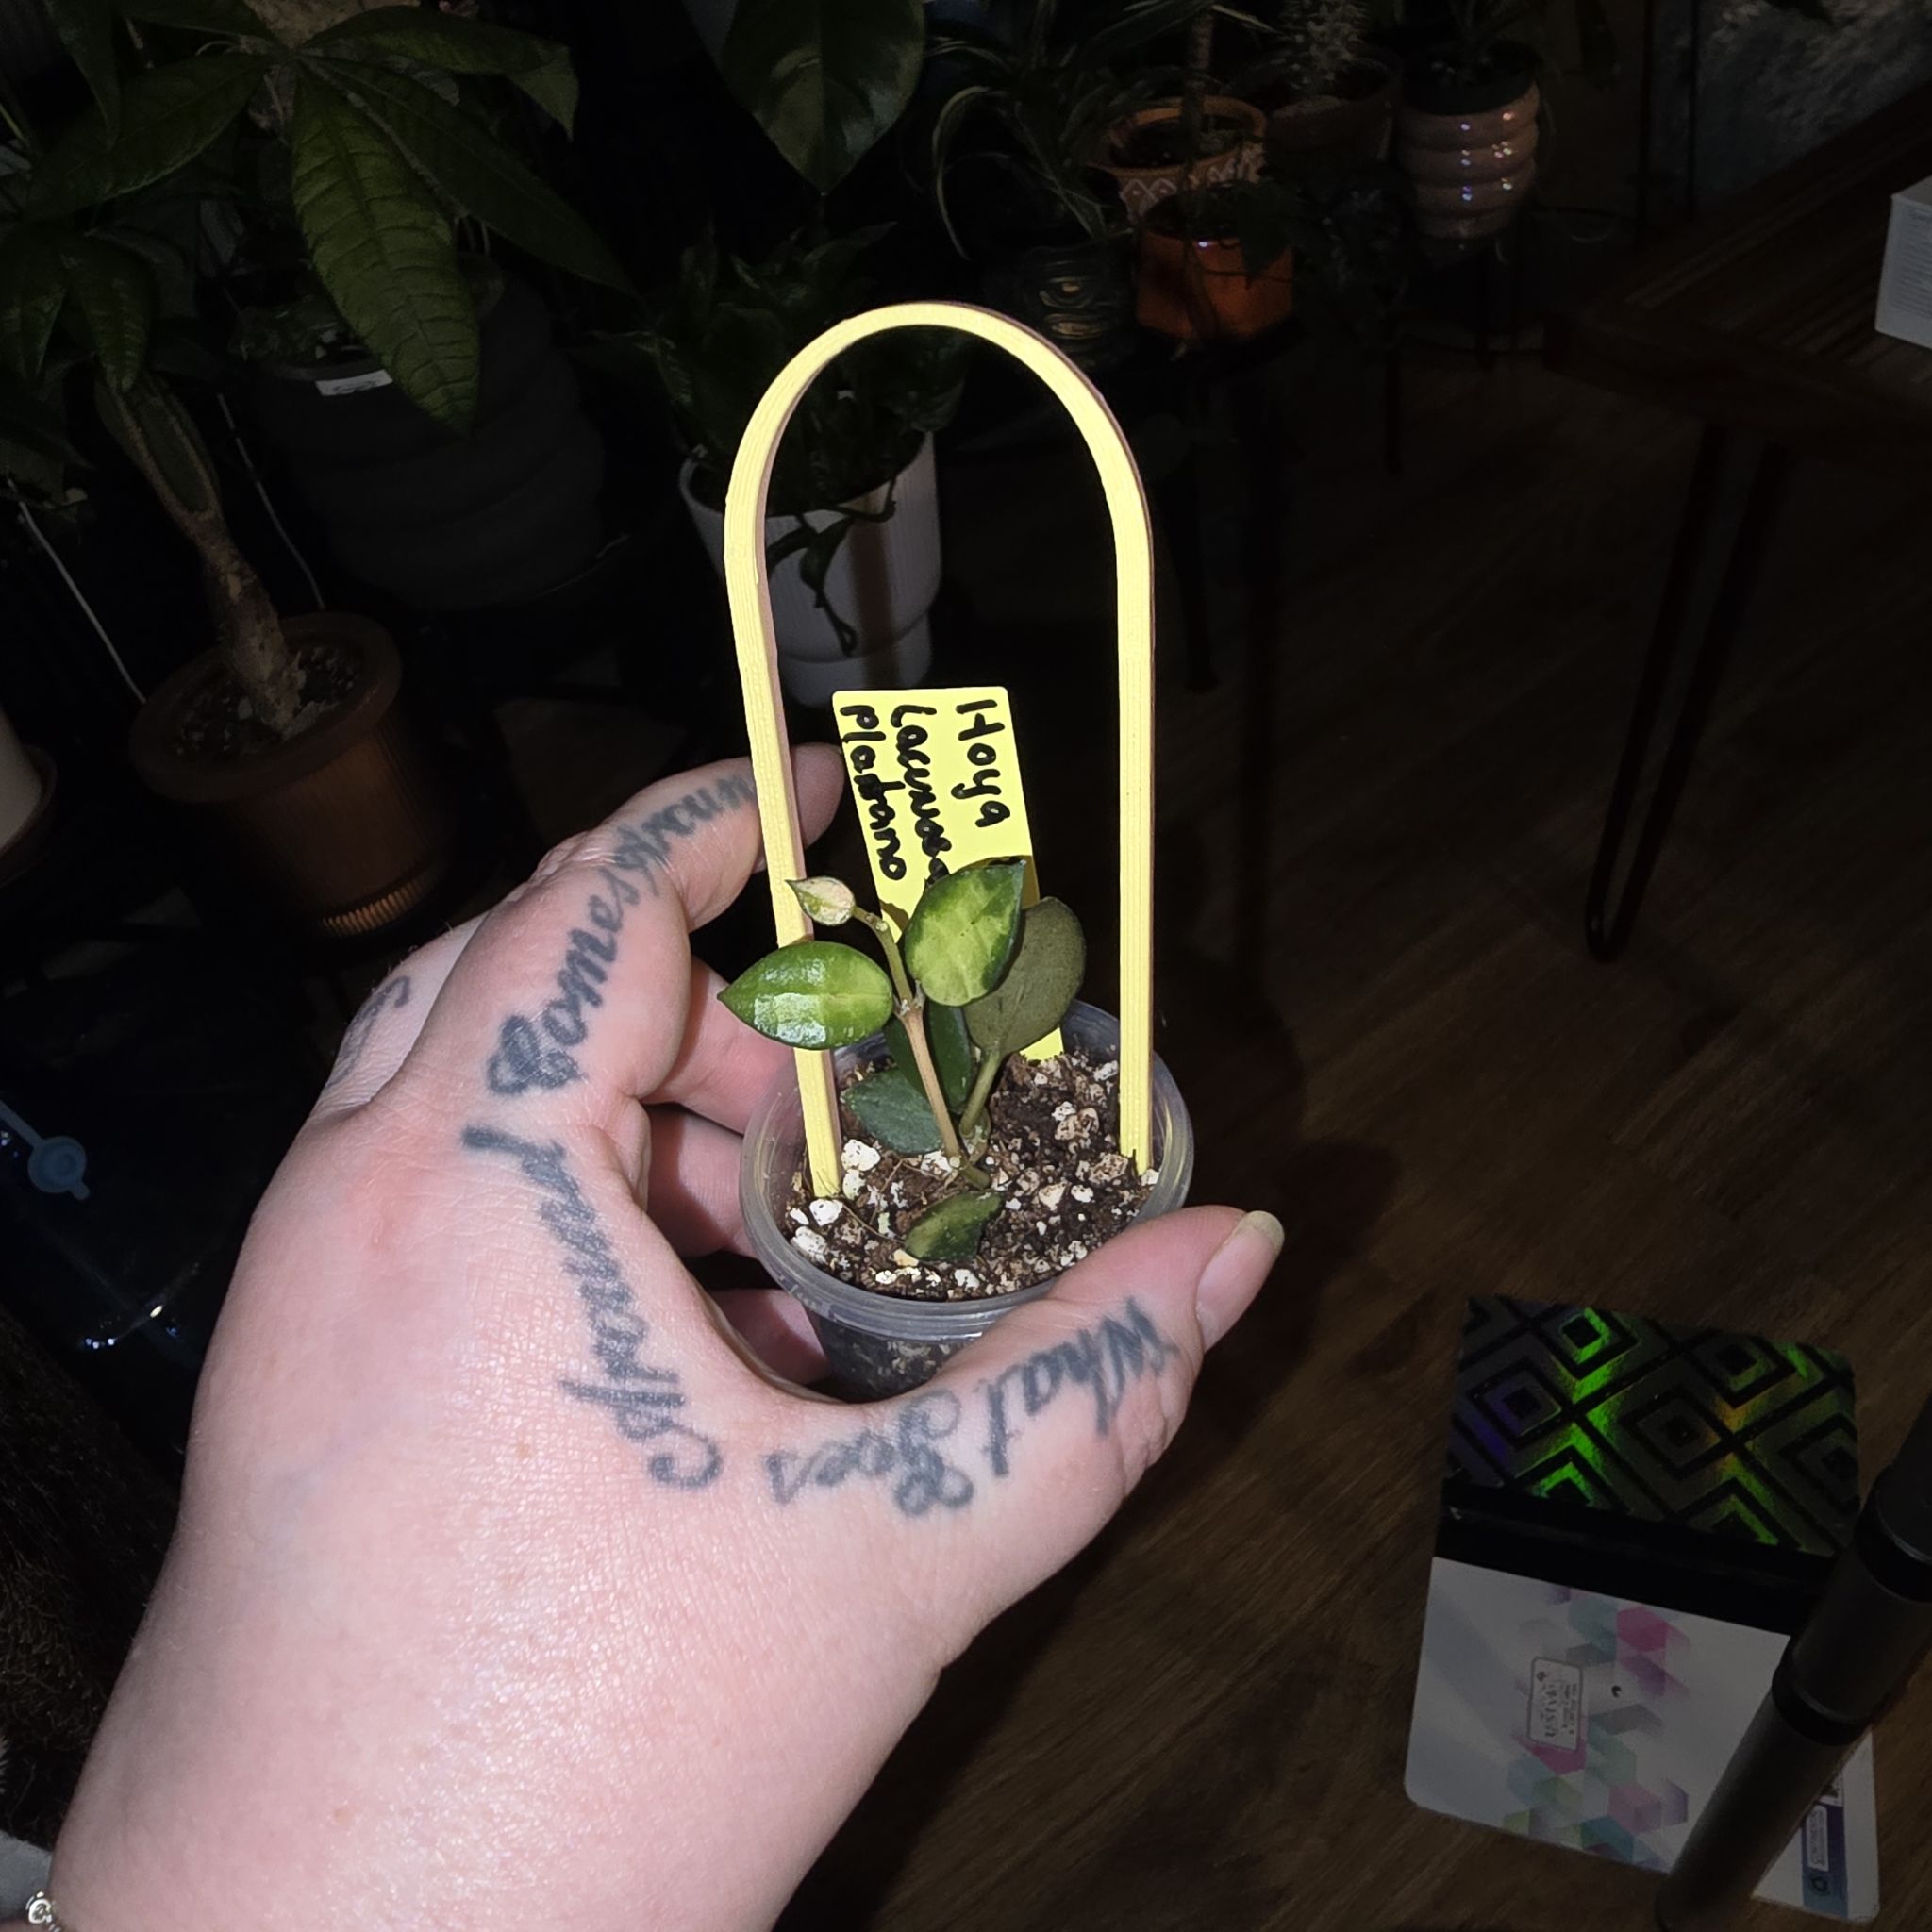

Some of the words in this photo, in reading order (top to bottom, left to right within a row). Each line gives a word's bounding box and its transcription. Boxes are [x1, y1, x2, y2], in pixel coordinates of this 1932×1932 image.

[611, 774, 755, 896] Aroun
[951, 699, 1010, 827] Hoya
[486, 865, 640, 1096] Comes
[974, 1294, 1178, 1477] What
